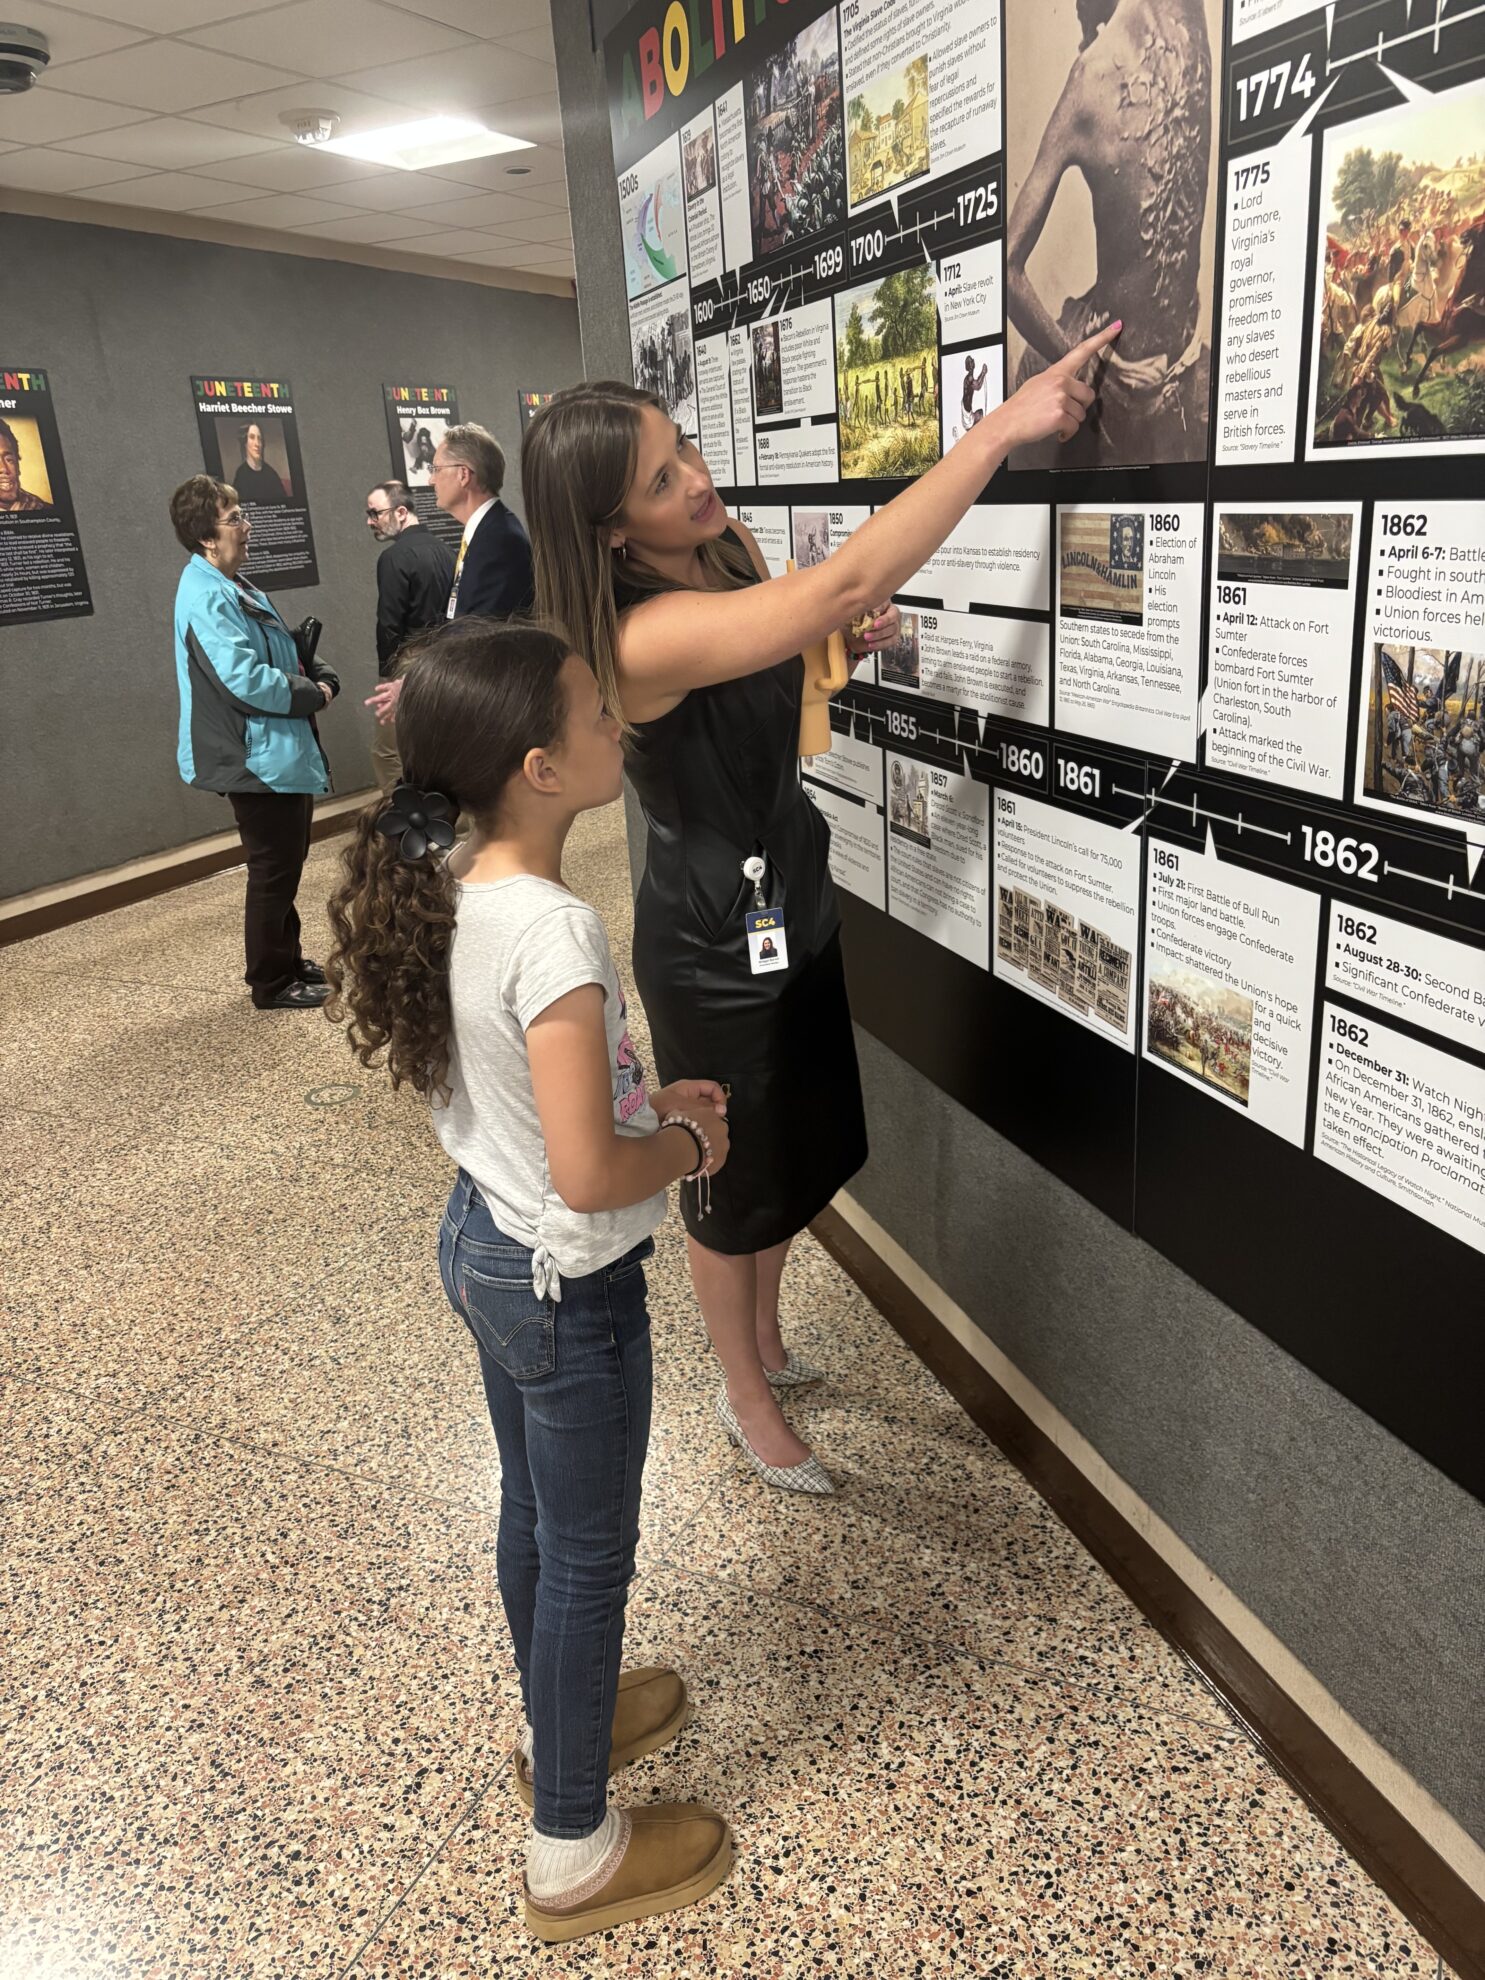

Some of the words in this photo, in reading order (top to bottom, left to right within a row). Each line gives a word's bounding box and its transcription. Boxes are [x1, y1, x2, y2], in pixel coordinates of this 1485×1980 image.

[842, 2, 860, 23] 1705
[1236, 53, 1316, 121] 1774
[618, 174, 639, 200] 1500s
[1233, 161, 1271, 192] 1775
[957, 181, 998, 226] 1725
[1240, 191, 1263, 210] Lord
[1232, 210, 1281, 232] Dunmore,
[850, 229, 884, 266] 1700
[1231, 229, 1275, 251] Virginia's
[814, 246, 844, 281] 1699
[944, 263, 961, 282] 1712
[1230, 252, 1253, 272] royal
[748, 276, 771, 304] 1650
[947, 283, 962, 298] April:
[962, 281, 977, 293] Slave
[977, 275, 993, 288] revolt
[1229, 270, 1275, 293] governor,
[693, 300, 715, 324] 1600
[944, 303, 949, 312] in
[949, 300, 962, 310] New
[962, 295, 975, 307] York
[975, 292, 987, 304] City
[1228, 290, 1272, 312] promises
[1228, 310, 1268, 328] freedom
[1270, 308, 1281, 320] to
[1226, 334, 1244, 348] any
[1245, 329, 1275, 344] slaves
[1226, 351, 1247, 365] who
[1248, 346, 1279, 362] desert
[1225, 367, 1271, 383] rebellious
[195, 380, 290, 399] JUNETEENTH
[1224, 388, 1262, 402] masters
[1263, 383, 1283, 398] and
[198, 402, 230, 412] Harriet
[231, 403, 266, 413] Beecher
[266, 404, 293, 414] Stowe
[396, 406, 416, 416] Henry
[417, 406, 430, 415] Box
[430, 406, 451, 416] Brown
[1223, 408, 1248, 420] serve
[1249, 404, 1258, 418] in
[1223, 424, 1252, 438] British
[1254, 422, 1286, 436] forces.
[829, 512, 844, 525] 1850
[1149, 514, 1180, 532] 1860
[1381, 514, 1428, 536] 1862
[1155, 536, 1186, 548] Election
[1188, 536, 1197, 548] of
[1387, 544, 1418, 562] April
[1421, 546, 1445, 560] 6-7:
[1148, 552, 1184, 565] Abraham
[1148, 568, 1176, 580] Lincoln
[1387, 565, 1431, 583] Fought
[1434, 567, 1446, 581] in
[1154, 584, 1167, 596] His
[1216, 585, 1247, 606] 1861
[1385, 584, 1442, 602] Bloodiest
[1445, 588, 1457, 602] in
[1147, 599, 1178, 613] election
[1384, 605, 1419, 620] Union
[1422, 607, 1461, 624] forces
[920, 615, 938, 630] 1859
[1147, 617, 1180, 630] prompts
[1222, 611, 1244, 626] April
[1246, 613, 1258, 626] 12:
[1259, 615, 1290, 630] Attack
[1292, 621, 1305, 631] on
[1308, 620, 1328, 634] Fort
[1373, 623, 1432, 642] victorious.
[1214, 627, 1248, 642] Sumter
[1221, 644, 1276, 663] Confederate
[1278, 651, 1307, 668] forces
[1214, 659, 1254, 677] bombard
[1256, 666, 1275, 680] Fort
[1277, 669, 1314, 686] Sumter
[1213, 676, 1242, 691] (Union
[1243, 680, 1260, 695] fort
[1261, 683, 1270, 696] in
[1272, 686, 1289, 700] the
[1290, 688, 1324, 706] harbor
[1325, 695, 1337, 708] of
[1212, 692, 1261, 714] Charleston,
[1263, 701, 1291, 718] South
[885, 709, 918, 741] 1855
[1212, 708, 1252, 729] Carolina).
[1218, 726, 1246, 742] Attack
[1248, 734, 1284, 750] marked
[1285, 740, 1302, 754] the
[999, 742, 1044, 780] 1860
[1211, 739, 1256, 763] beginning
[1257, 751, 1267, 763] of
[1268, 753, 1284, 767] the
[1285, 757, 1306, 772] Civil
[1308, 762, 1330, 778] War.
[930, 771, 948, 788] 1857
[1056, 758, 1101, 798] 1861
[996, 797, 1016, 816] 1861
[1000, 816, 1015, 829] April
[1014, 821, 1023, 832] 15:
[1023, 824, 1050, 842] President
[1051, 835, 1077, 852] Lincoln's
[1077, 846, 1089, 856] call
[1089, 848, 1099, 860] for
[1099, 852, 1122, 869] 75,000
[1152, 848, 1180, 872] 1861
[1300, 825, 1380, 883] 1862
[1157, 871, 1174, 888] July
[1175, 877, 1186, 890] 21:
[1187, 882, 1204, 898] First
[1206, 889, 1230, 907] Battle
[1231, 900, 1241, 910] of
[1242, 902, 1259, 918] Bull
[1261, 910, 1280, 926] Run
[755, 917, 776, 929] SC4
[1336, 913, 1378, 945] 1862
[1155, 927, 1203, 956] Confederate
[1204, 948, 1232, 970] victory
[1342, 943, 1383, 967] August
[1385, 958, 1422, 982] 28-30:
[1424, 973, 1470, 1000] Second
[1342, 961, 1398, 993] Significant
[1401, 984, 1475, 1023] Confederate
[1329, 1013, 1369, 1047] 1862
[1336, 1042, 1392, 1077] December
[1394, 1069, 1409, 1086] 31:
[1412, 1077, 1450, 1105] Watch
[1454, 1097, 1485, 1121] Nigh
[1334, 1058, 1350, 1074] On
[1352, 1066, 1409, 1102] December
[1410, 1094, 1424, 1112] 31,
[1427, 1102, 1455, 1128] 1862,
[1325, 1071, 1361, 1096] African
[1362, 1089, 1421, 1126] Americans
[1423, 1121, 1479, 1156] gathered
[1325, 1085, 1348, 1105] New
[1349, 1098, 1374, 1120] Year.
[1376, 1111, 1403, 1136] They
[1405, 1128, 1434, 1150] were
[1322, 1116, 1350, 1140] taken
[1352, 1135, 1384, 1159] effect.
[1323, 1101, 1340, 1118] the
[1342, 1111, 1418, 1159] Emancipation
